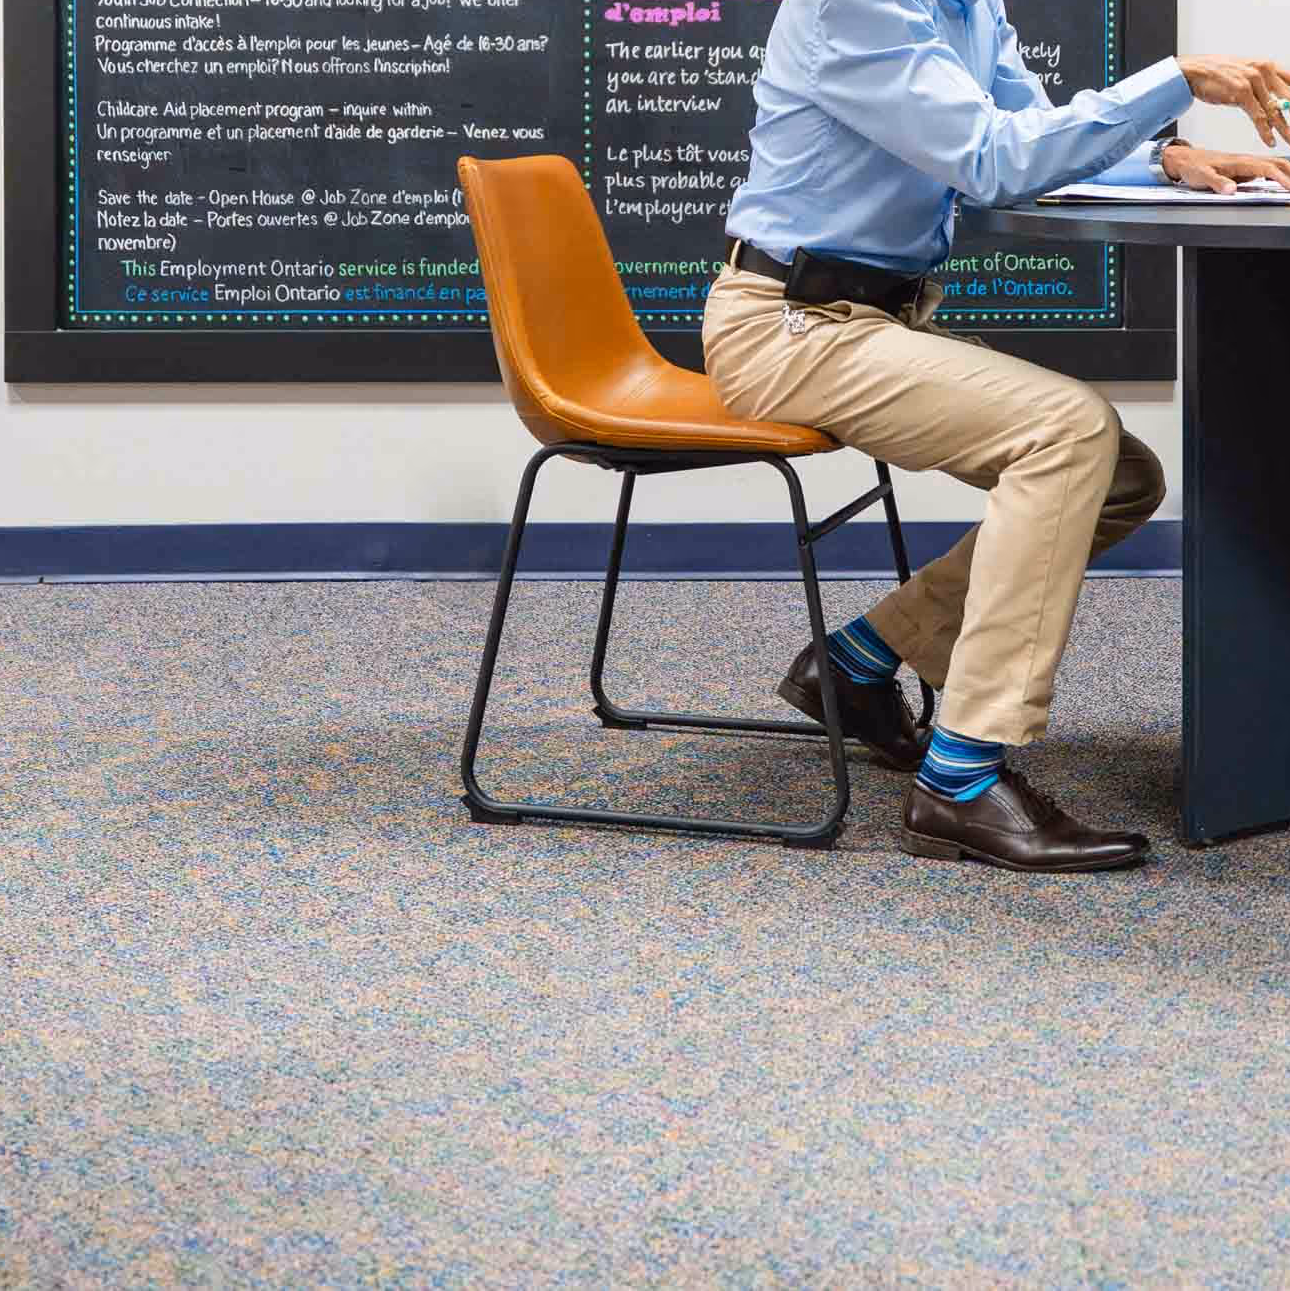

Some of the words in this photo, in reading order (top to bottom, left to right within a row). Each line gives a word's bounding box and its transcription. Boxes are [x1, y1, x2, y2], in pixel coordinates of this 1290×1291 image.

[96, 15, 171, 30] continuous
[604, 2, 722, 27] d'emploi
[606, 98, 631, 113] an
[637, 94, 722, 112] interview
[121, 260, 156, 277] This
[160, 259, 266, 280] Employment
[271, 260, 334, 278] Ontario
[339, 261, 397, 277] service
[403, 260, 415, 276] is
[420, 258, 480, 277] funded
